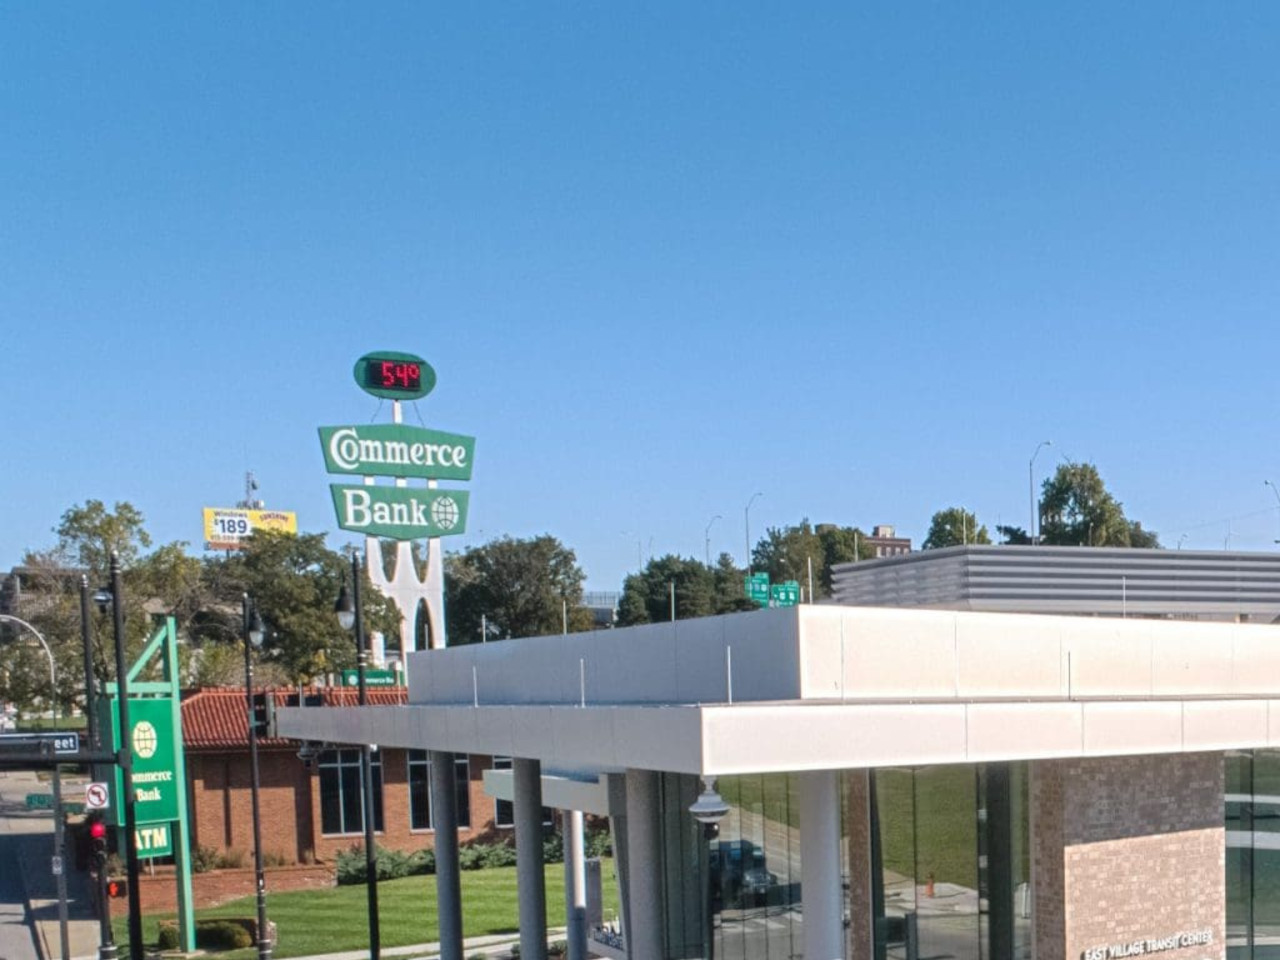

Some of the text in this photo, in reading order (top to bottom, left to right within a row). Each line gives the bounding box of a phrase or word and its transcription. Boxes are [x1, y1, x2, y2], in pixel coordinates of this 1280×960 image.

[330, 427, 467, 470] Commerce
[342, 489, 429, 527] Bank
[136, 787, 162, 802] Bank
[1109, 941, 1145, 957] VILLAGE
[1146, 936, 1179, 952] TRANSIT
[1182, 930, 1213, 946] CENTER
